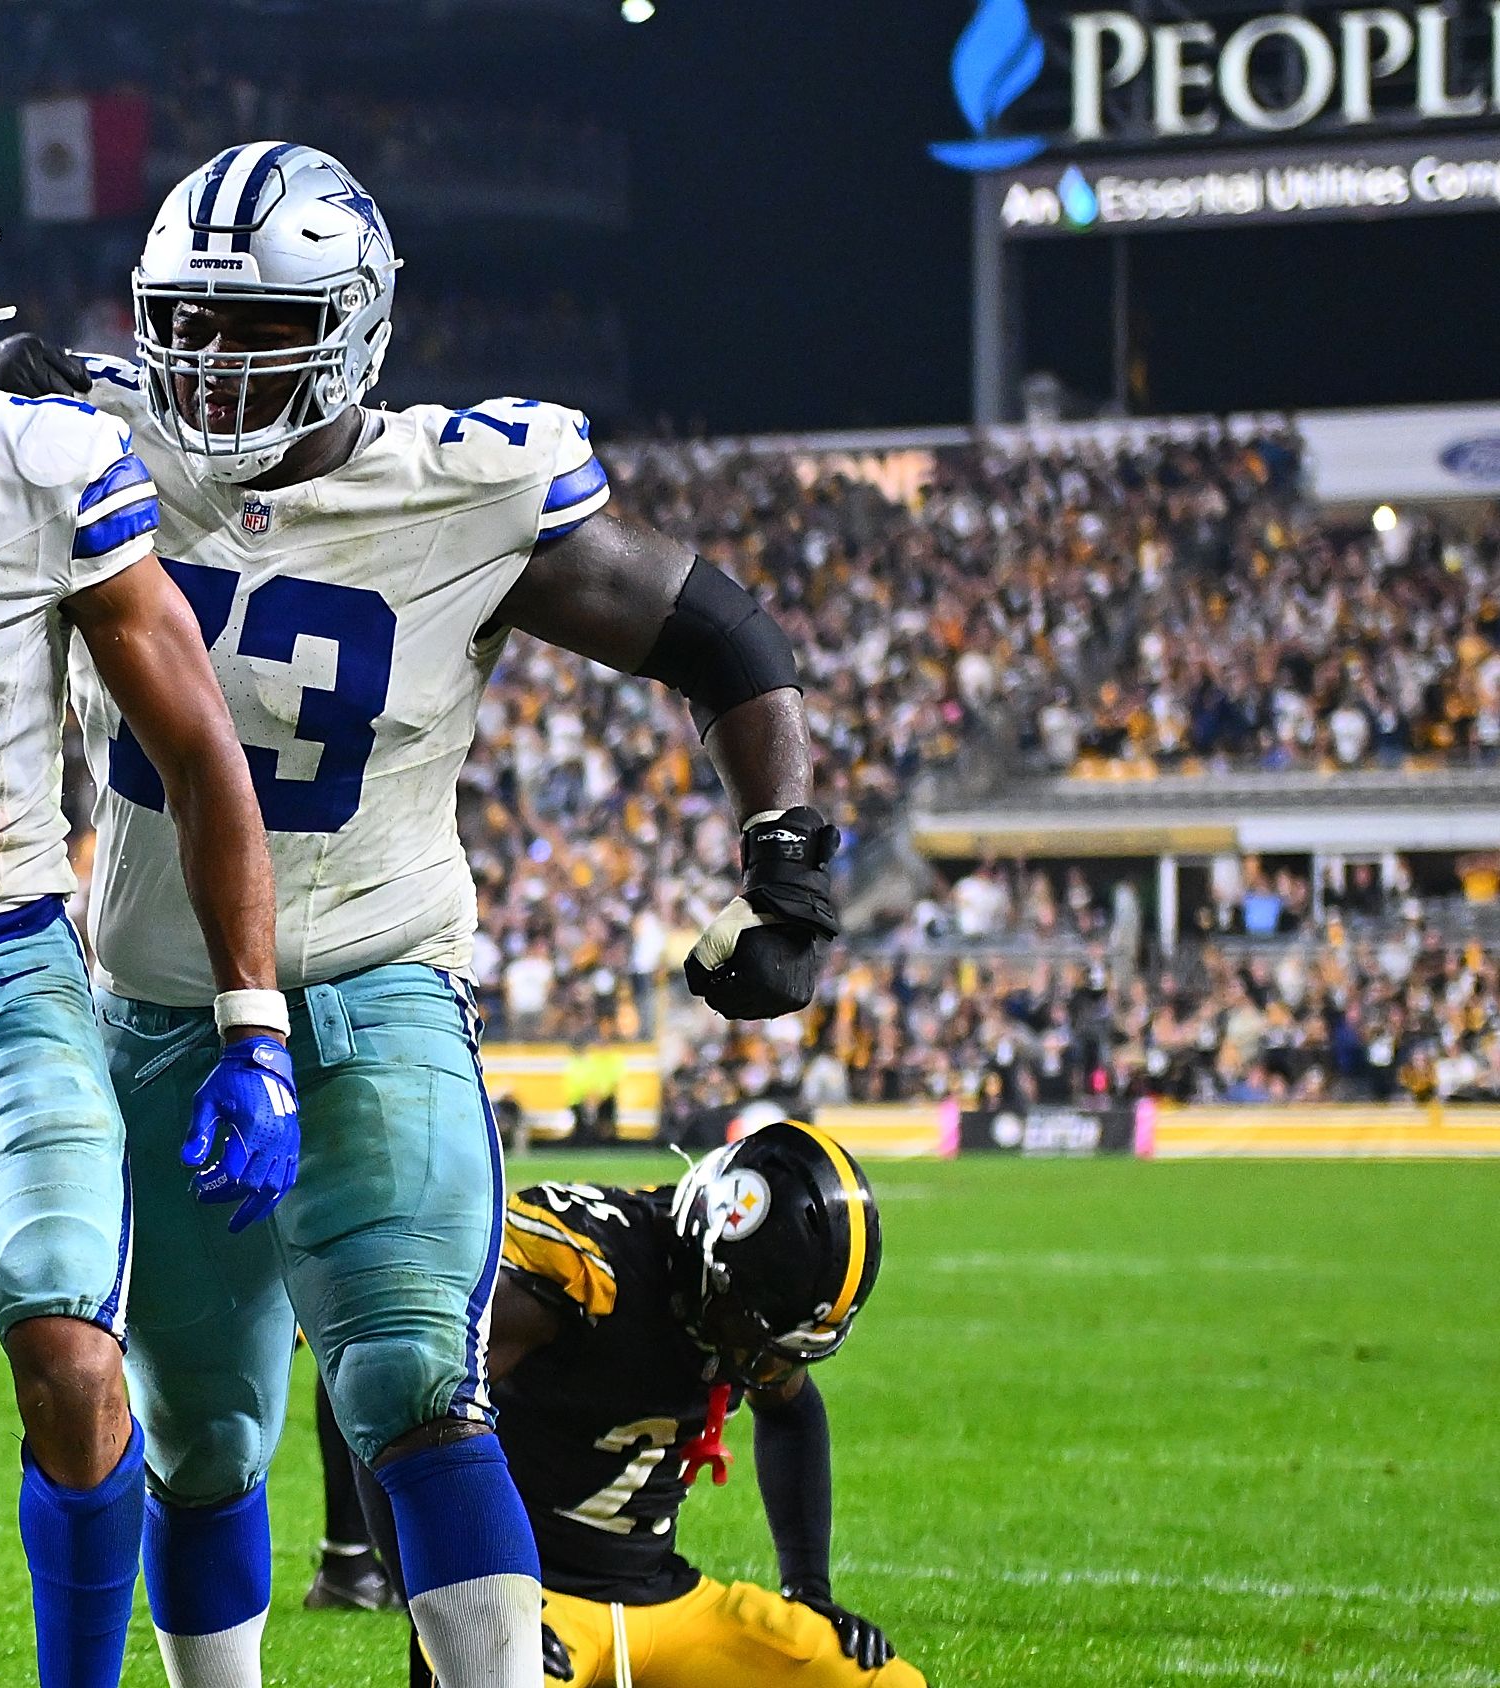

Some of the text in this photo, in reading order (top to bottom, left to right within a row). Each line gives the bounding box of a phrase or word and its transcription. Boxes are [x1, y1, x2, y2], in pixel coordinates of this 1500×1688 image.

[1070, 5, 1500, 142] PEOPL
[1001, 180, 1060, 228] An
[1097, 172, 1262, 223] Essential
[1411, 155, 1500, 203] Com
[190, 258, 243, 270] COWBOYS
[245, 513, 267, 530] NFL
